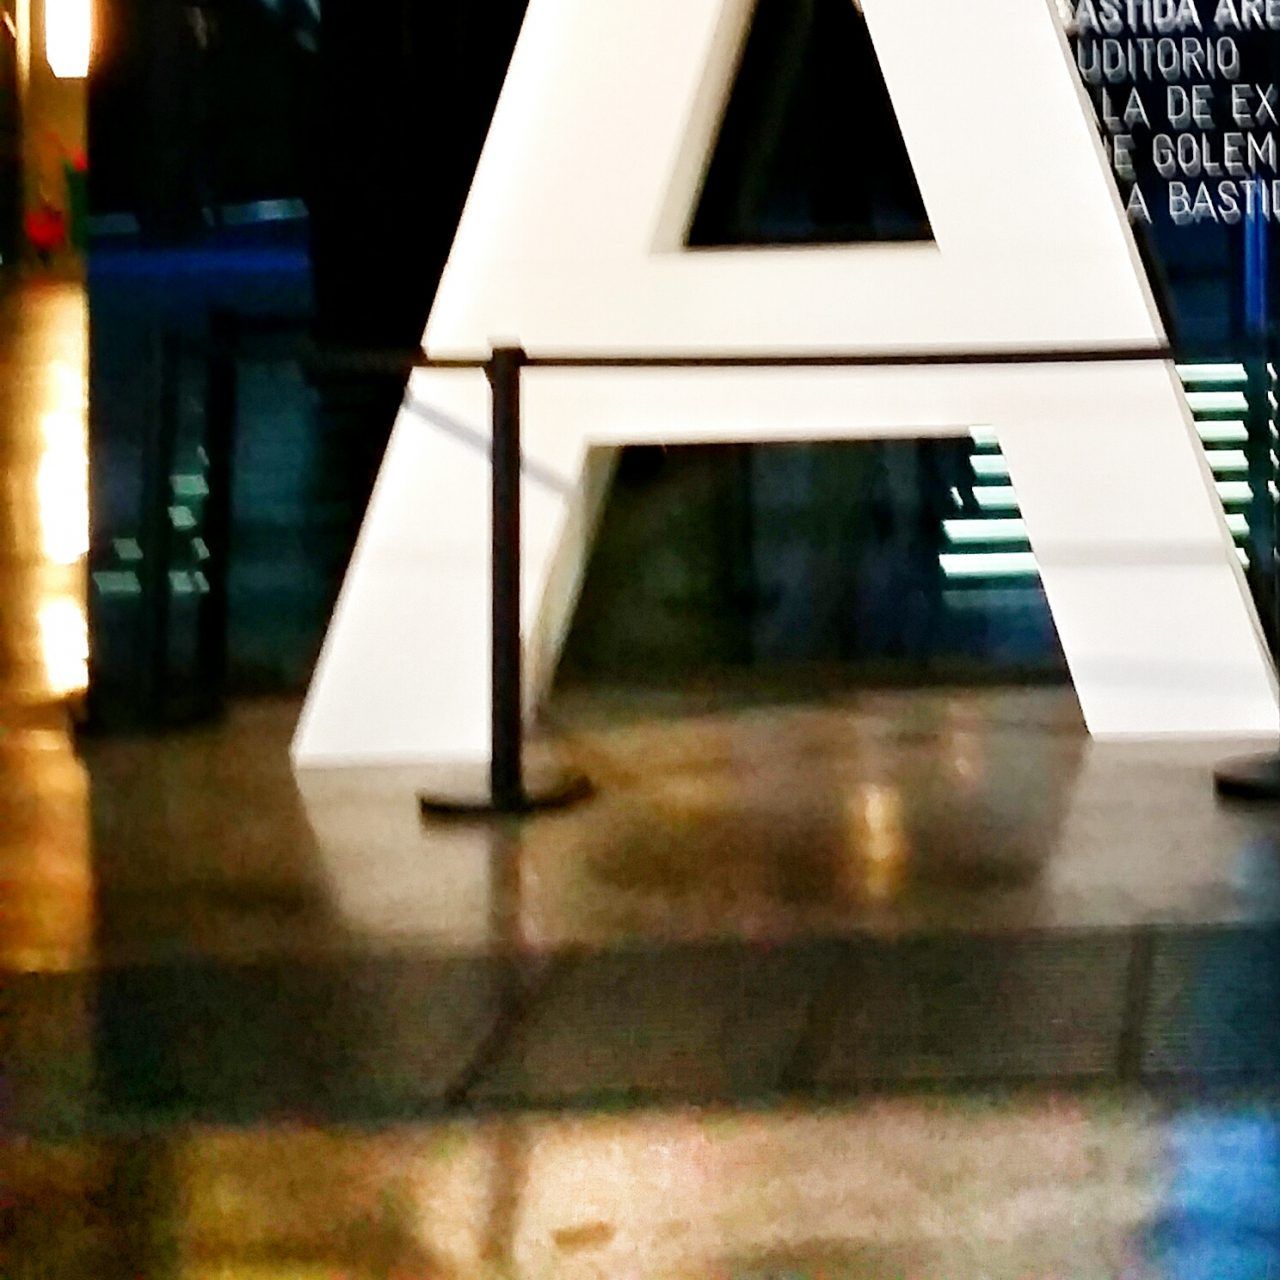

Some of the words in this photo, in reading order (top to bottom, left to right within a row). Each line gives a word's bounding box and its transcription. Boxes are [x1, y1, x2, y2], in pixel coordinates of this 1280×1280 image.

[1077, 36, 1241, 83] UDITORIO
[1102, 85, 1152, 133] LA
[1167, 84, 1216, 131] DE
[1152, 131, 1278, 179] GOLEM
[1126, 181, 1153, 225] A
